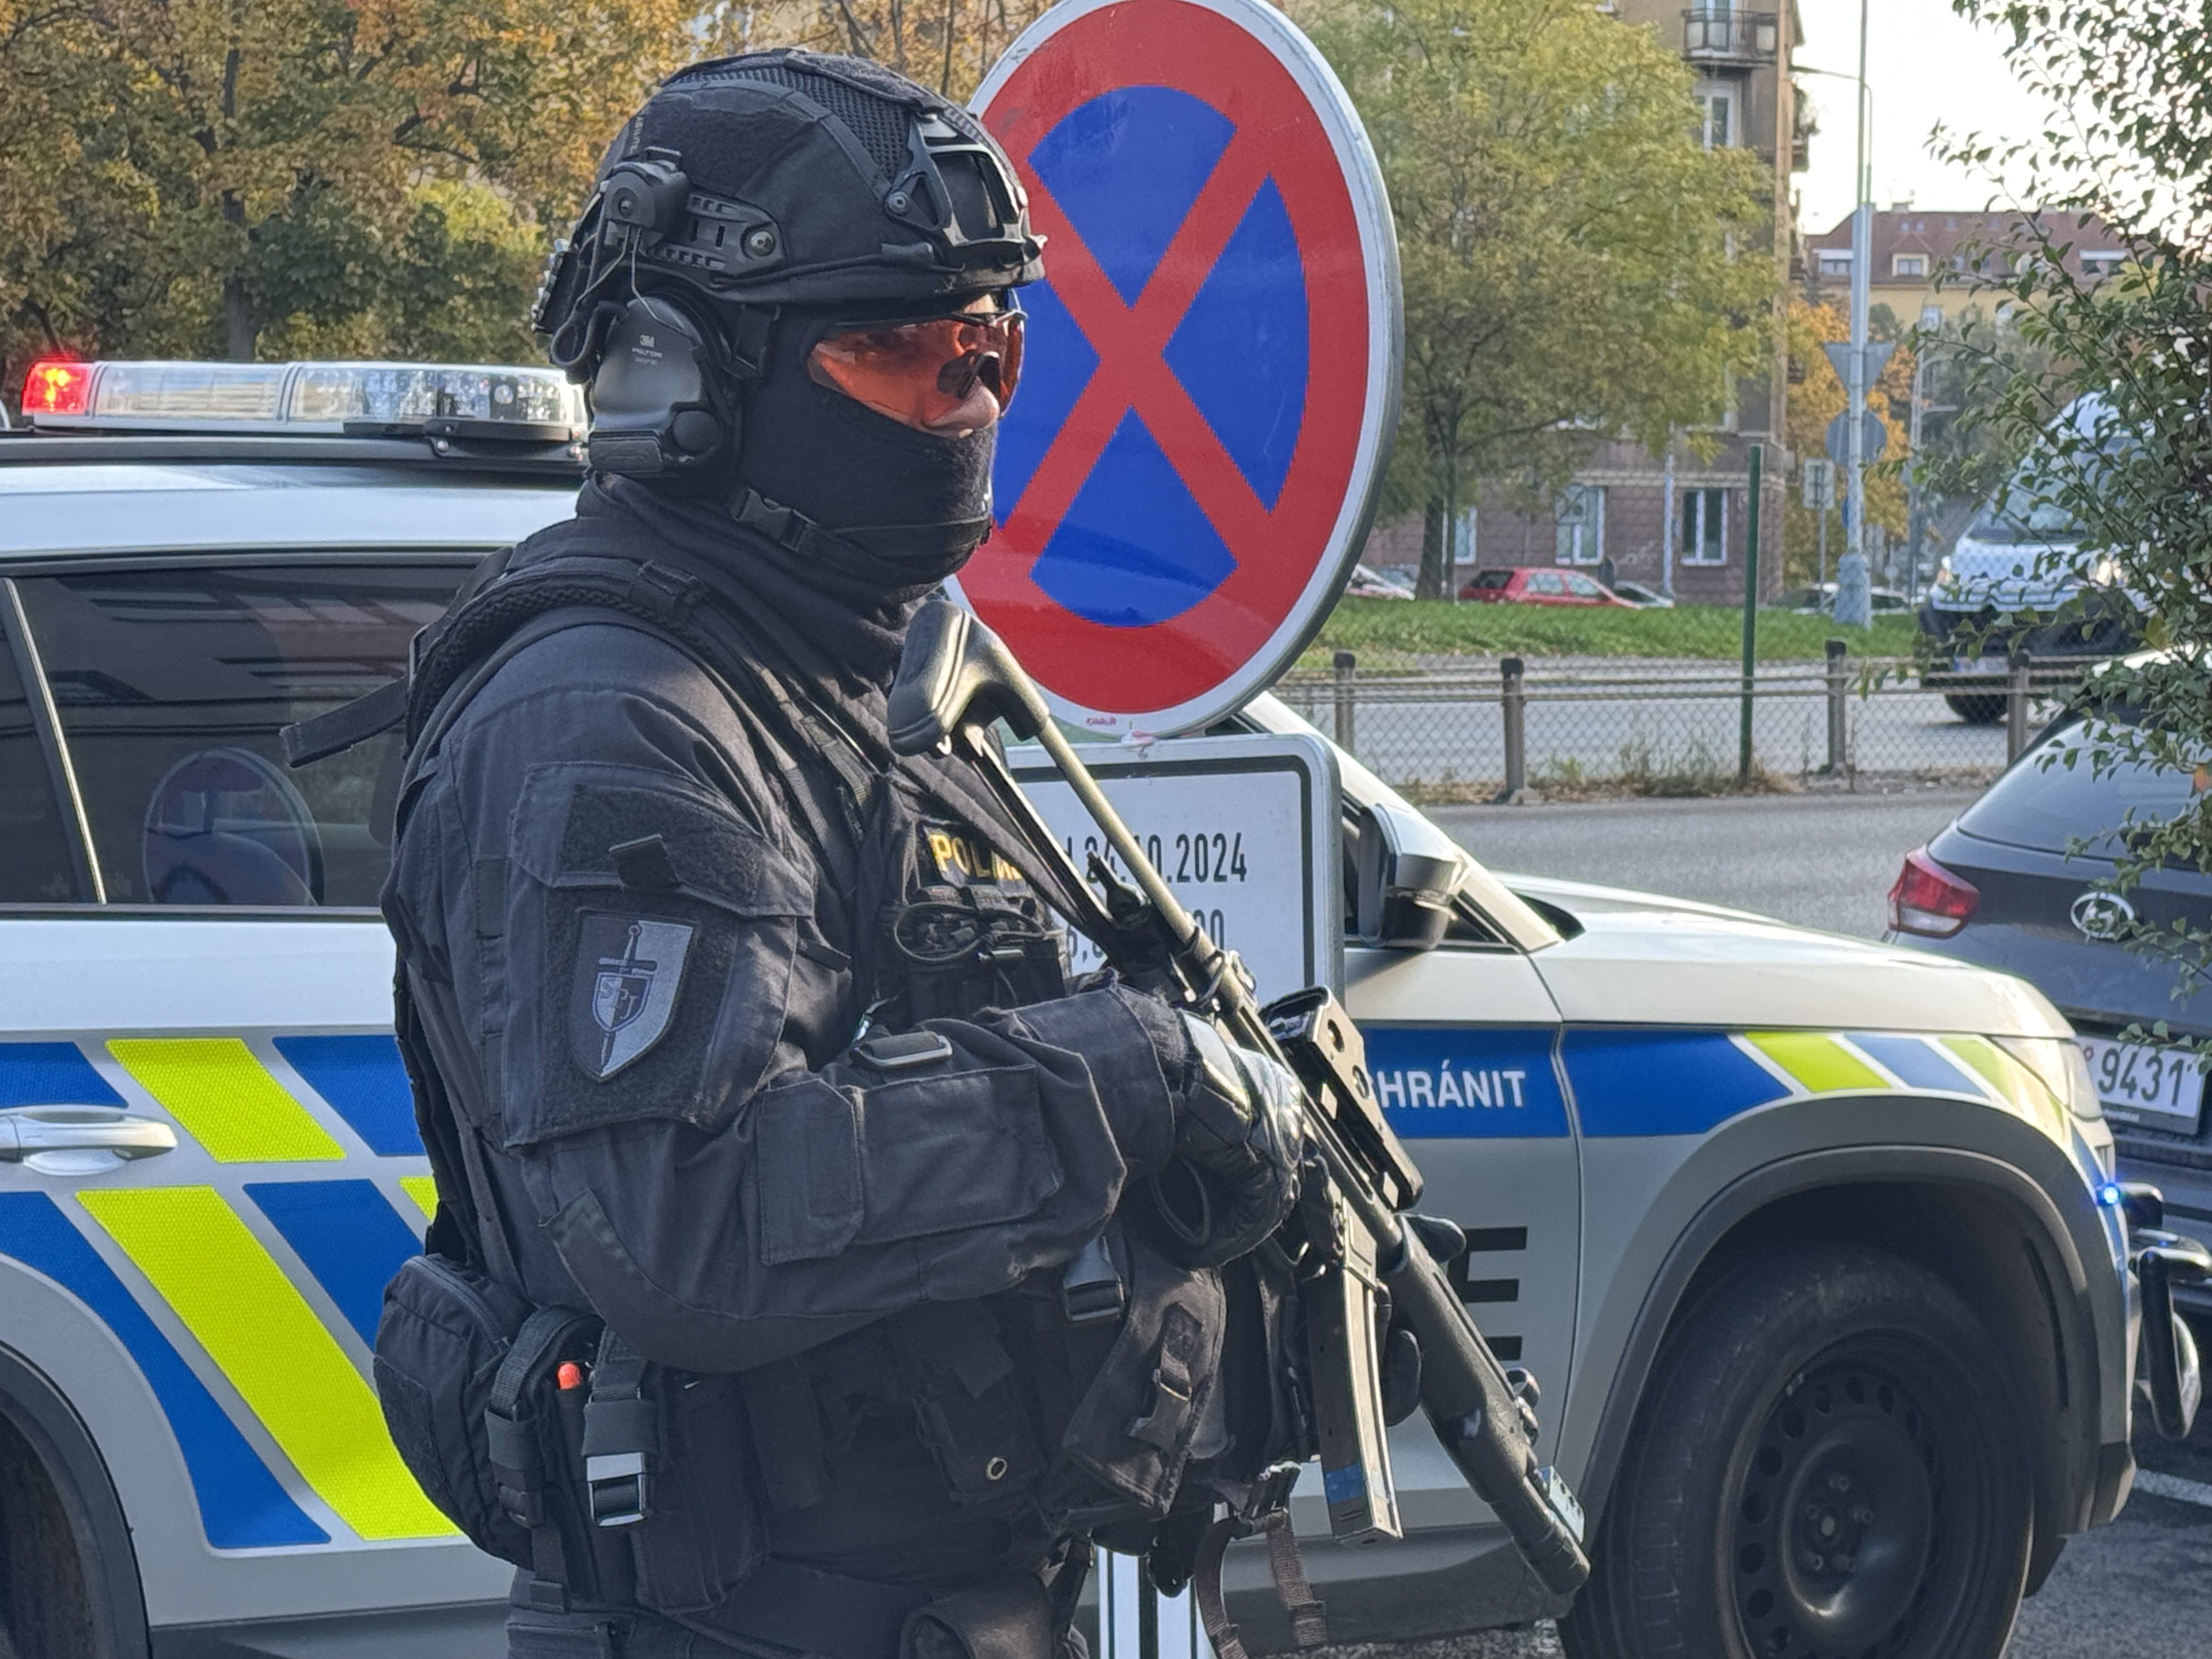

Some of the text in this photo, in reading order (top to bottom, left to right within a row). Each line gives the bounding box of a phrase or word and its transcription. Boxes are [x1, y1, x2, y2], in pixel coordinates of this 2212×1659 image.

[640, 335, 654, 348] 3M
[1369, 1059, 1526, 1108] HRÁNIT
[2098, 1047, 2185, 1107] 9431
